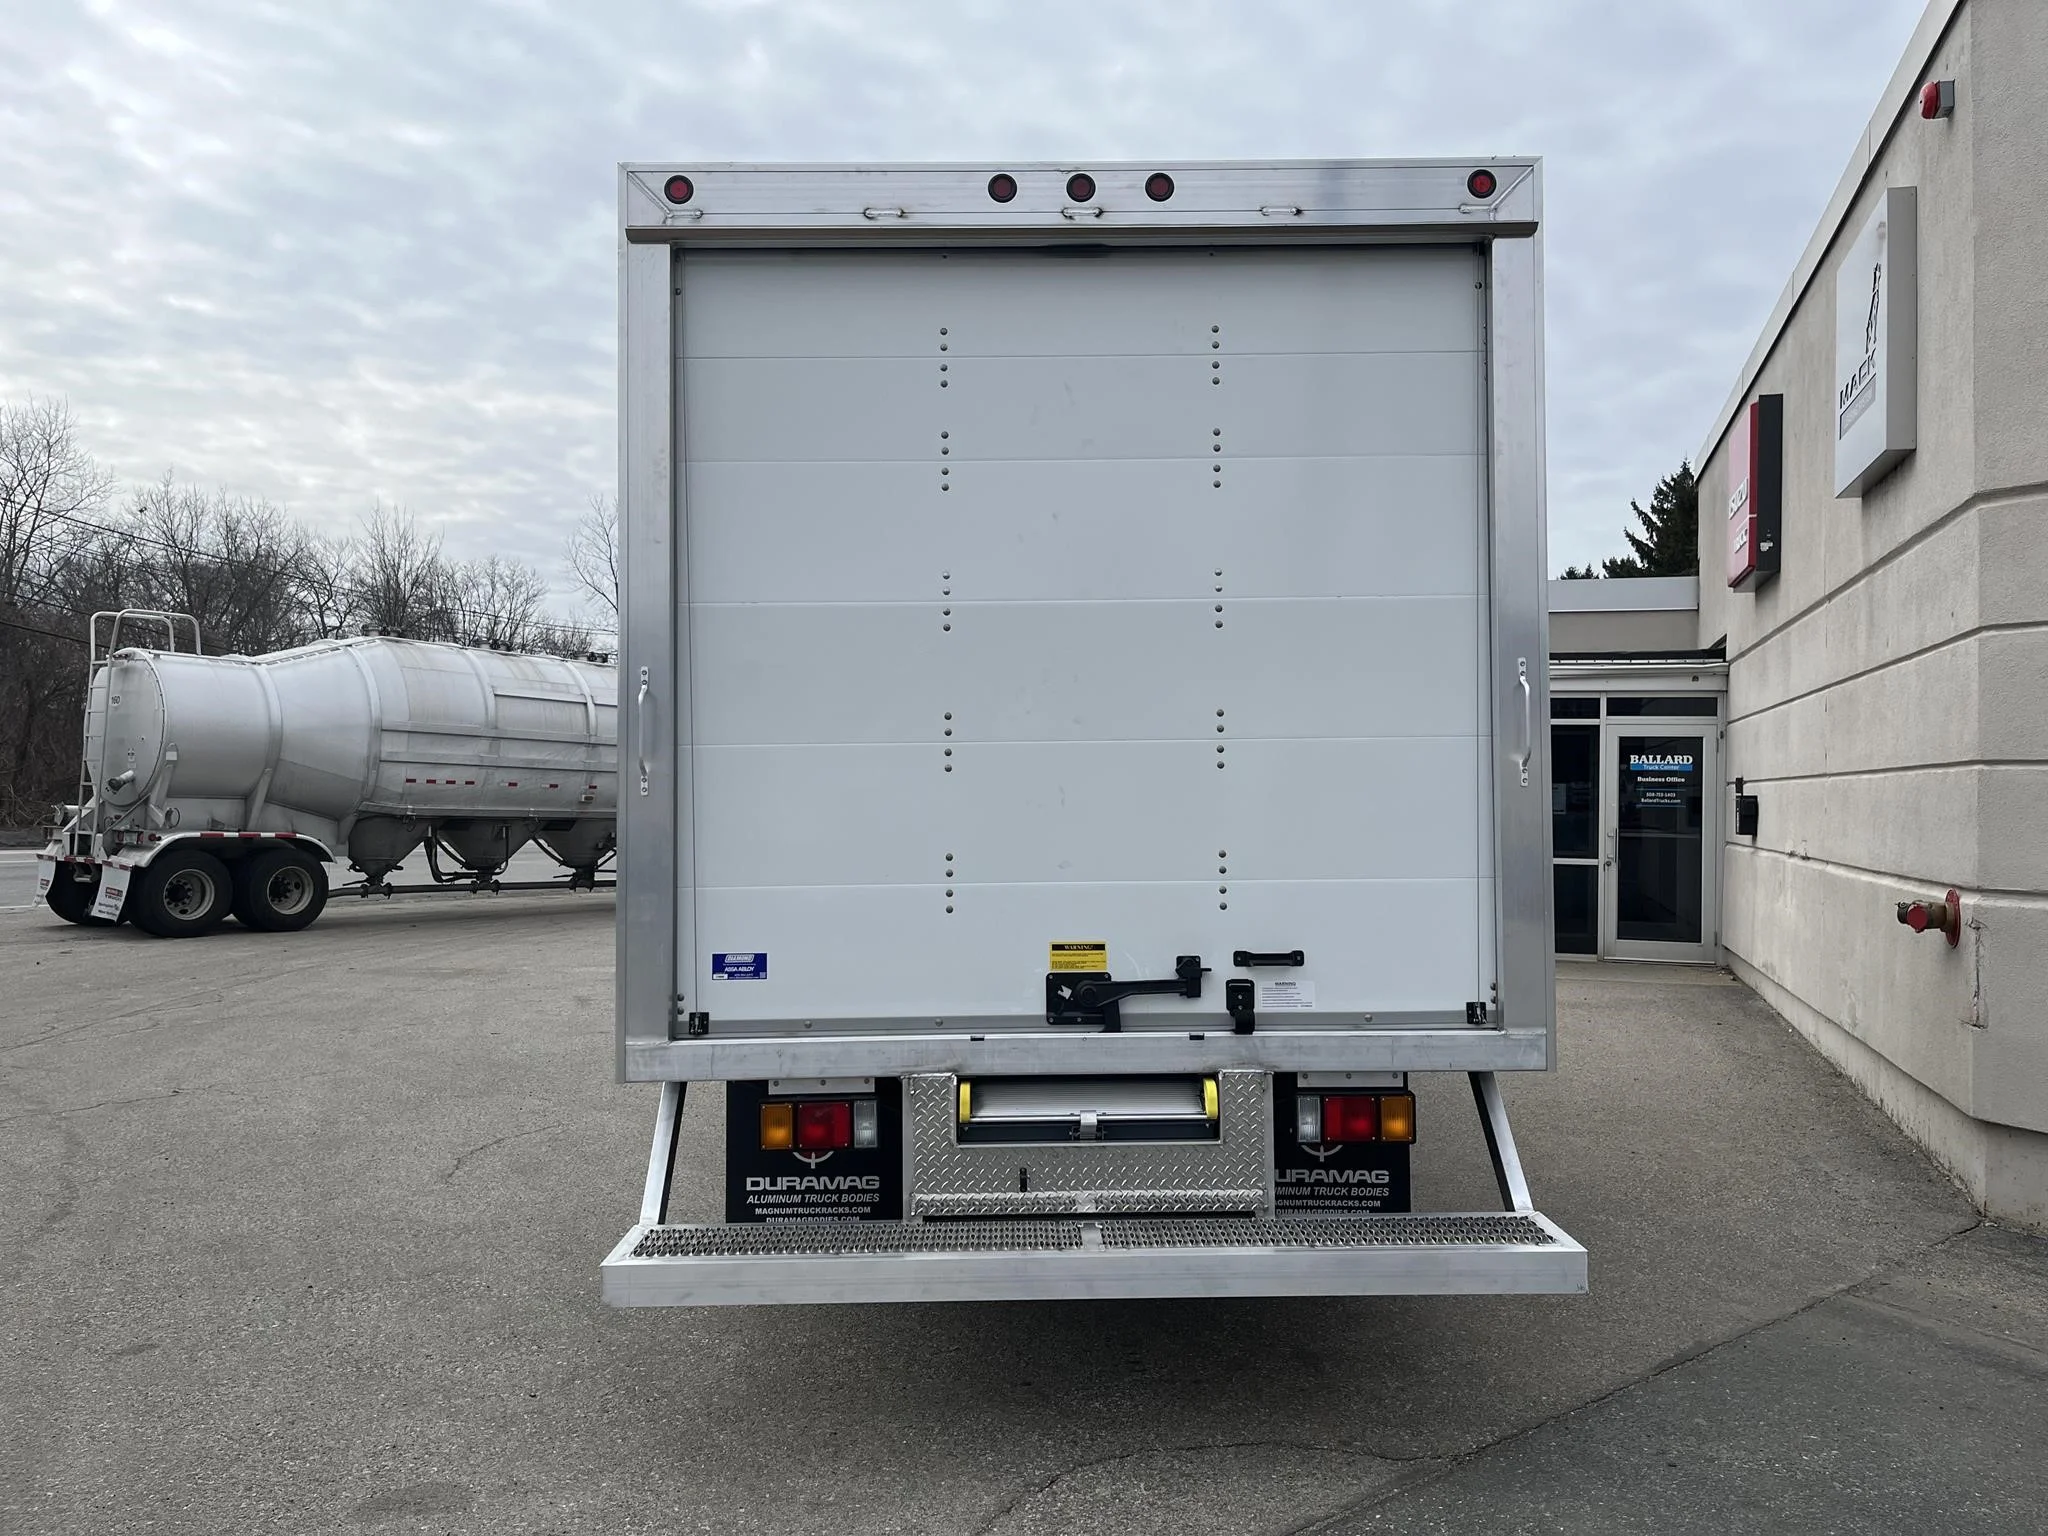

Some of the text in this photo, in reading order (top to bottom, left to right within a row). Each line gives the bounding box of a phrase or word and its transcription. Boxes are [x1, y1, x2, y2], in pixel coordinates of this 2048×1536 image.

[1840, 348, 1876, 409] MACK
[1630, 755, 1693, 764] BALLARD
[1275, 1169, 1389, 1183] URAMAG
[746, 1176, 880, 1191] DURAMAG
[1313, 1187, 1349, 1196] TRUCK
[1351, 1187, 1390, 1197] BODIES
[746, 1193, 880, 1204] ALUMINUM TRUCK BODIES
[755, 1206, 871, 1215] MAGNUMTRUCKRACKS.COM
